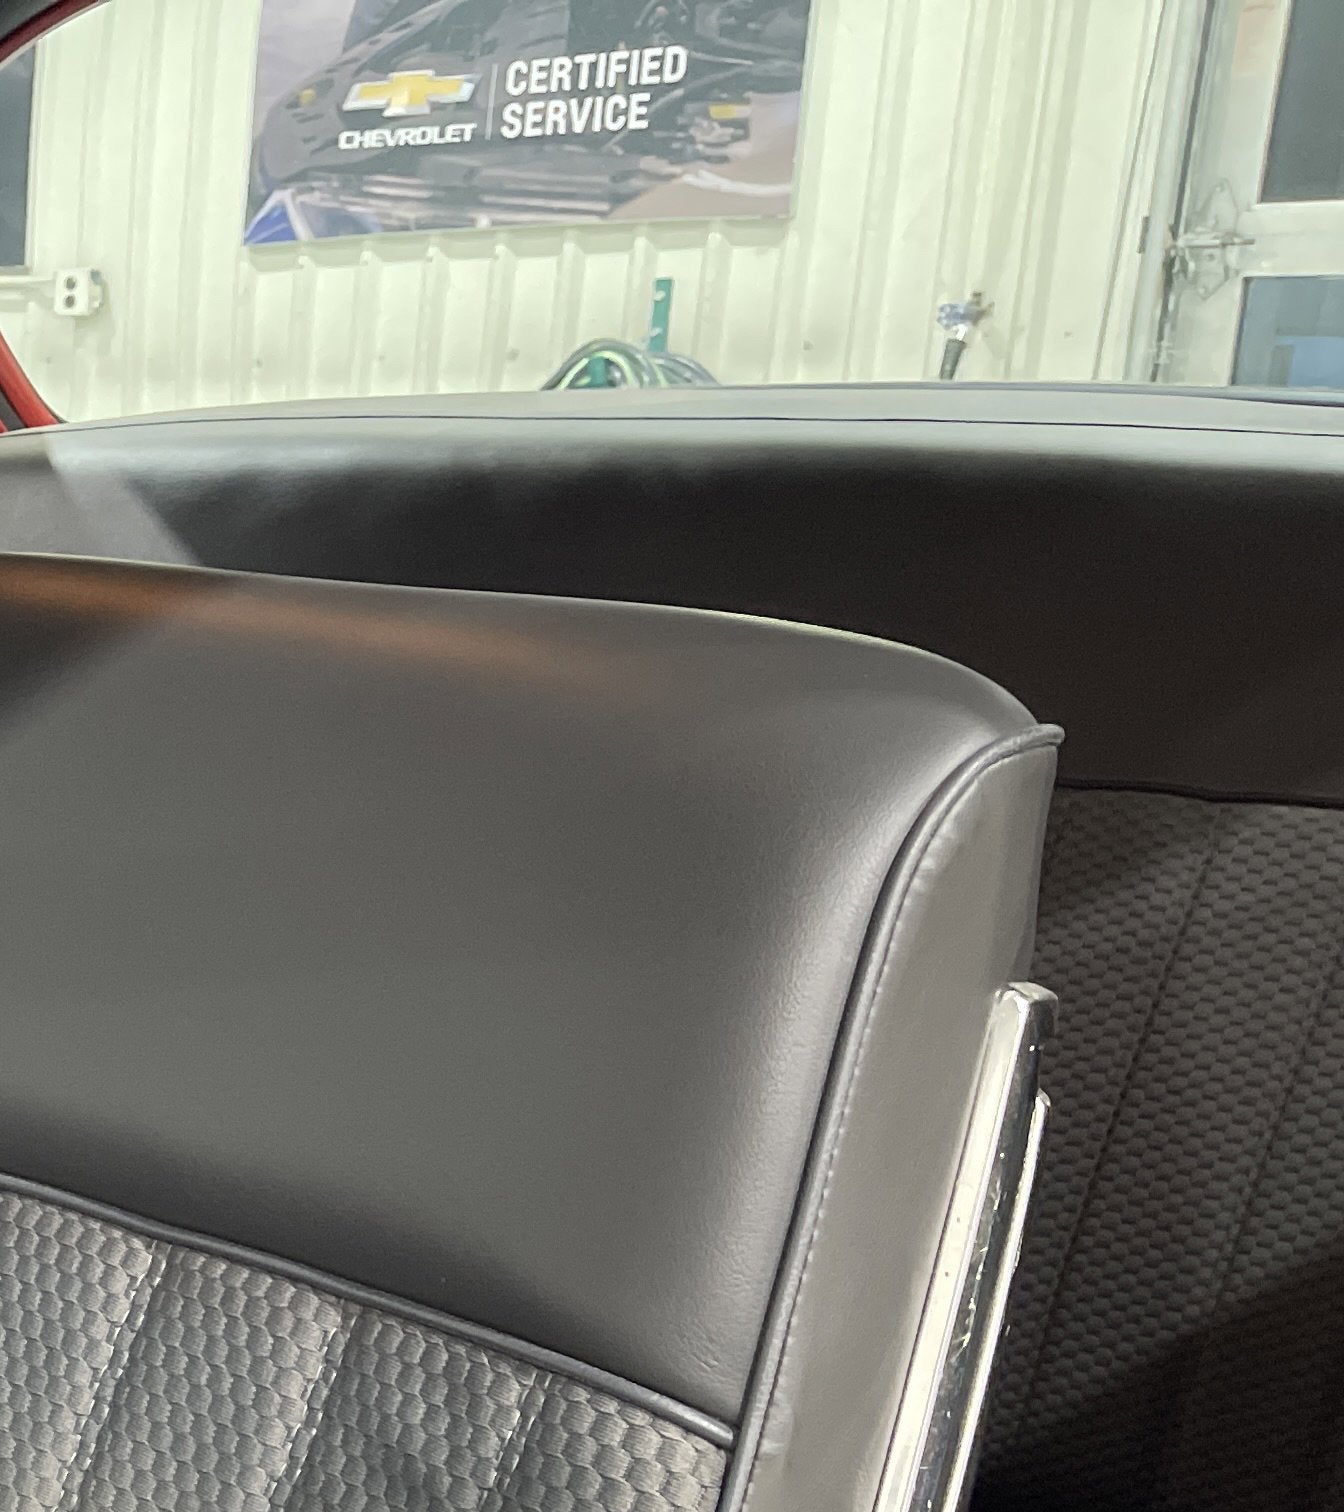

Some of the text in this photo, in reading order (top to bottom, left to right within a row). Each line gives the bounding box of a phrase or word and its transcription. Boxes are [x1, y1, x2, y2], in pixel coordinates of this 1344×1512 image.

[505, 45, 689, 97] CERTIFIED
[337, 122, 478, 151] CHEVROLET
[499, 92, 652, 140] SERVICE
